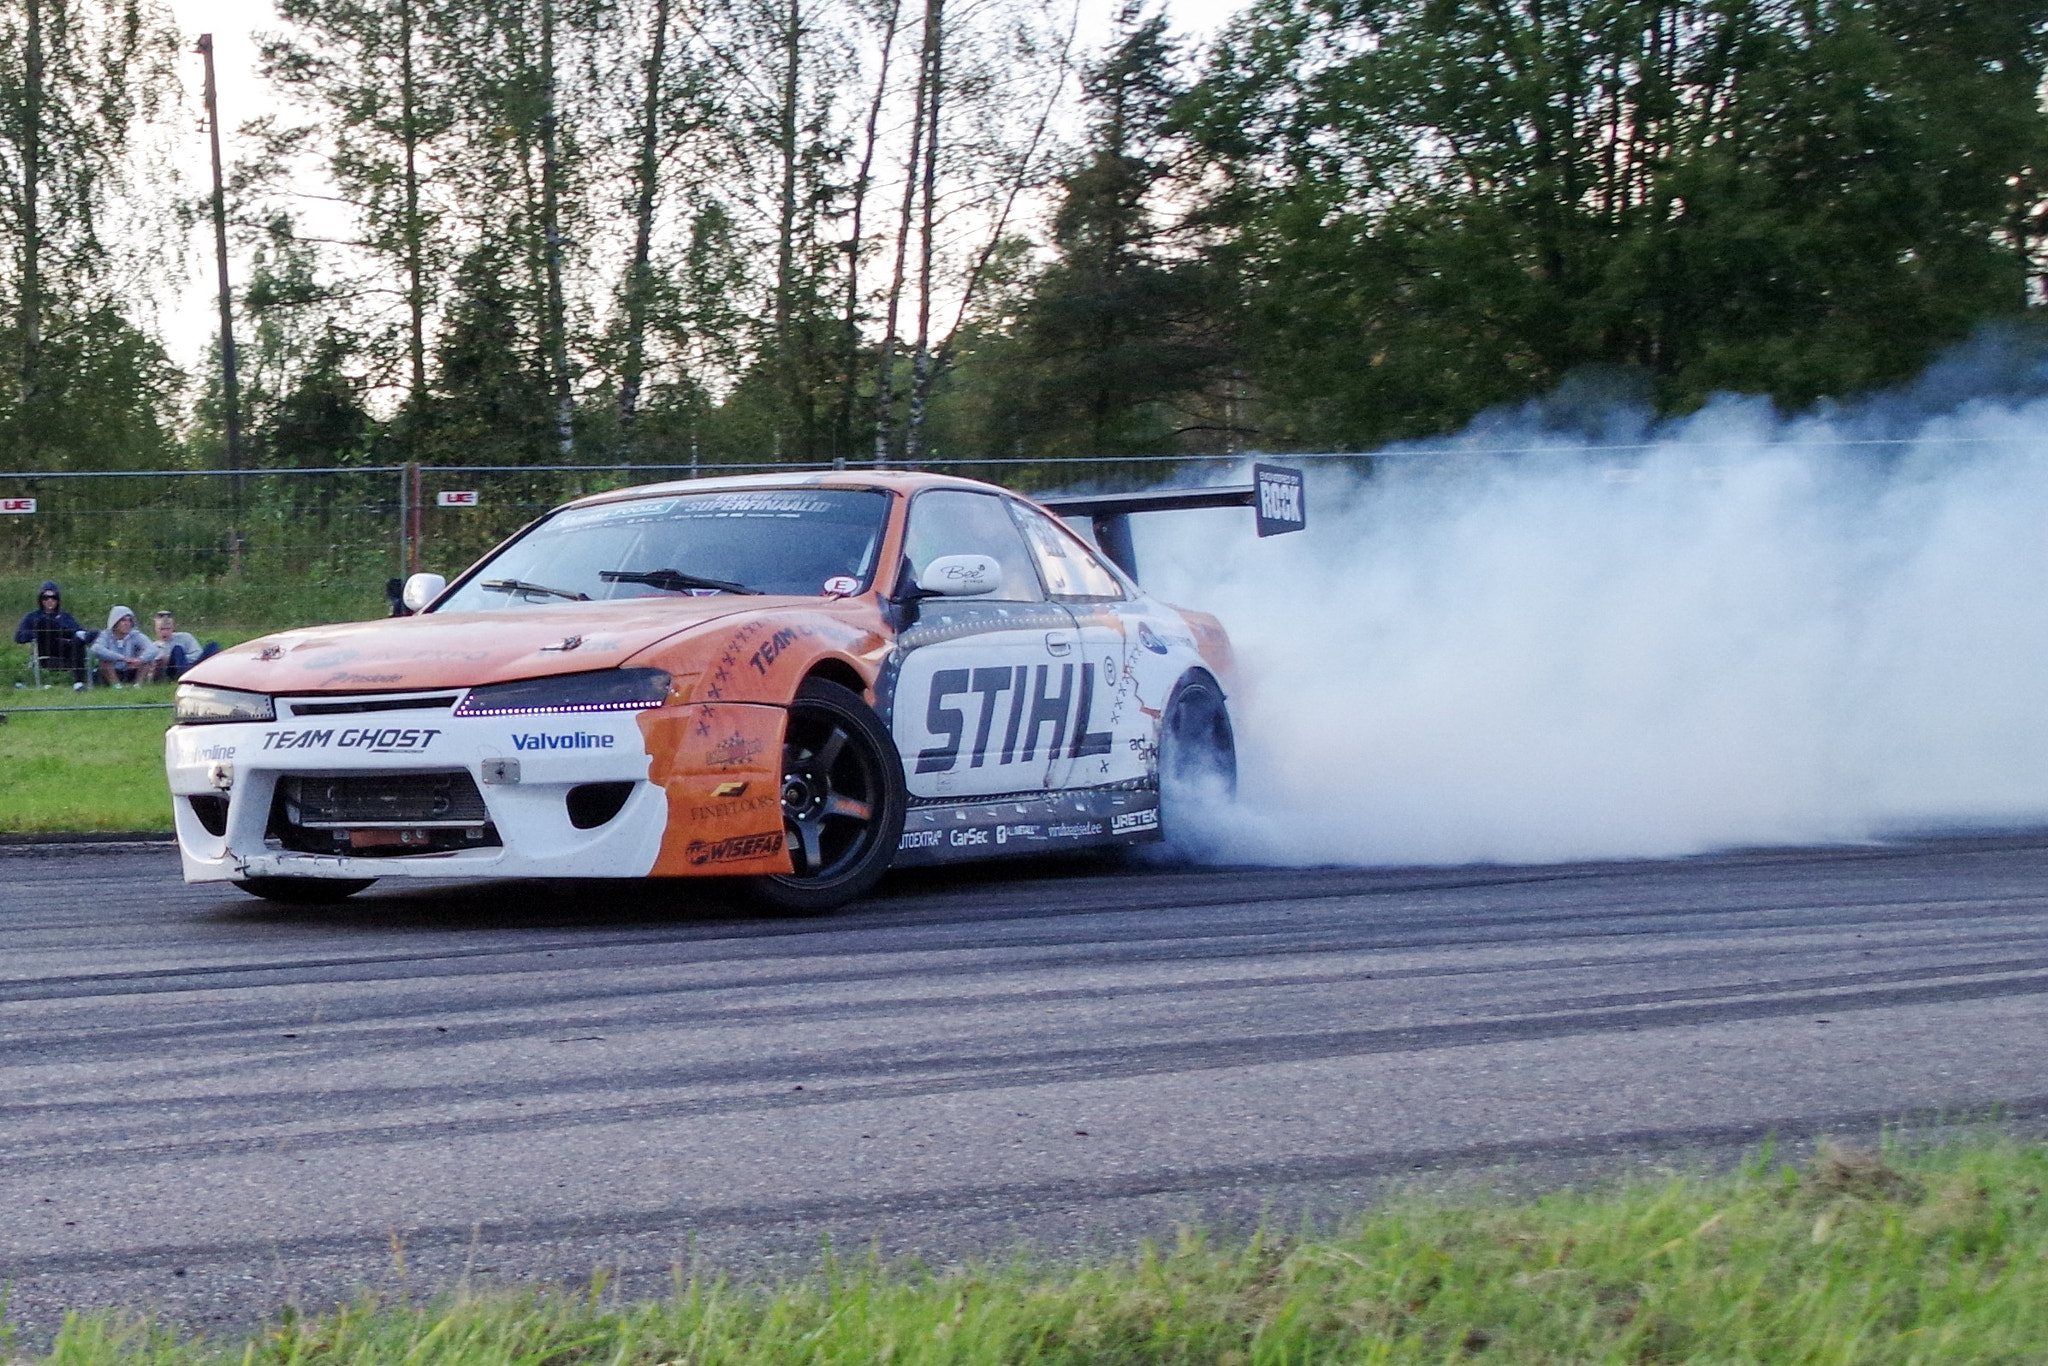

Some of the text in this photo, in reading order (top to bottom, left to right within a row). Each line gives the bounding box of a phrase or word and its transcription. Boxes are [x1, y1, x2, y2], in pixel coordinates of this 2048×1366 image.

[1260, 481, 1301, 522] ROCK
[834, 580, 847, 590] E
[750, 627, 798, 675] TEAM
[914, 663, 1113, 774] STIHL
[263, 728, 442, 750] TEAM GHOST
[512, 730, 615, 751] Valvoline
[1111, 808, 1158, 829] URETEK
[898, 830, 939, 850] UTOEXTRA
[950, 828, 988, 847] CarSec
